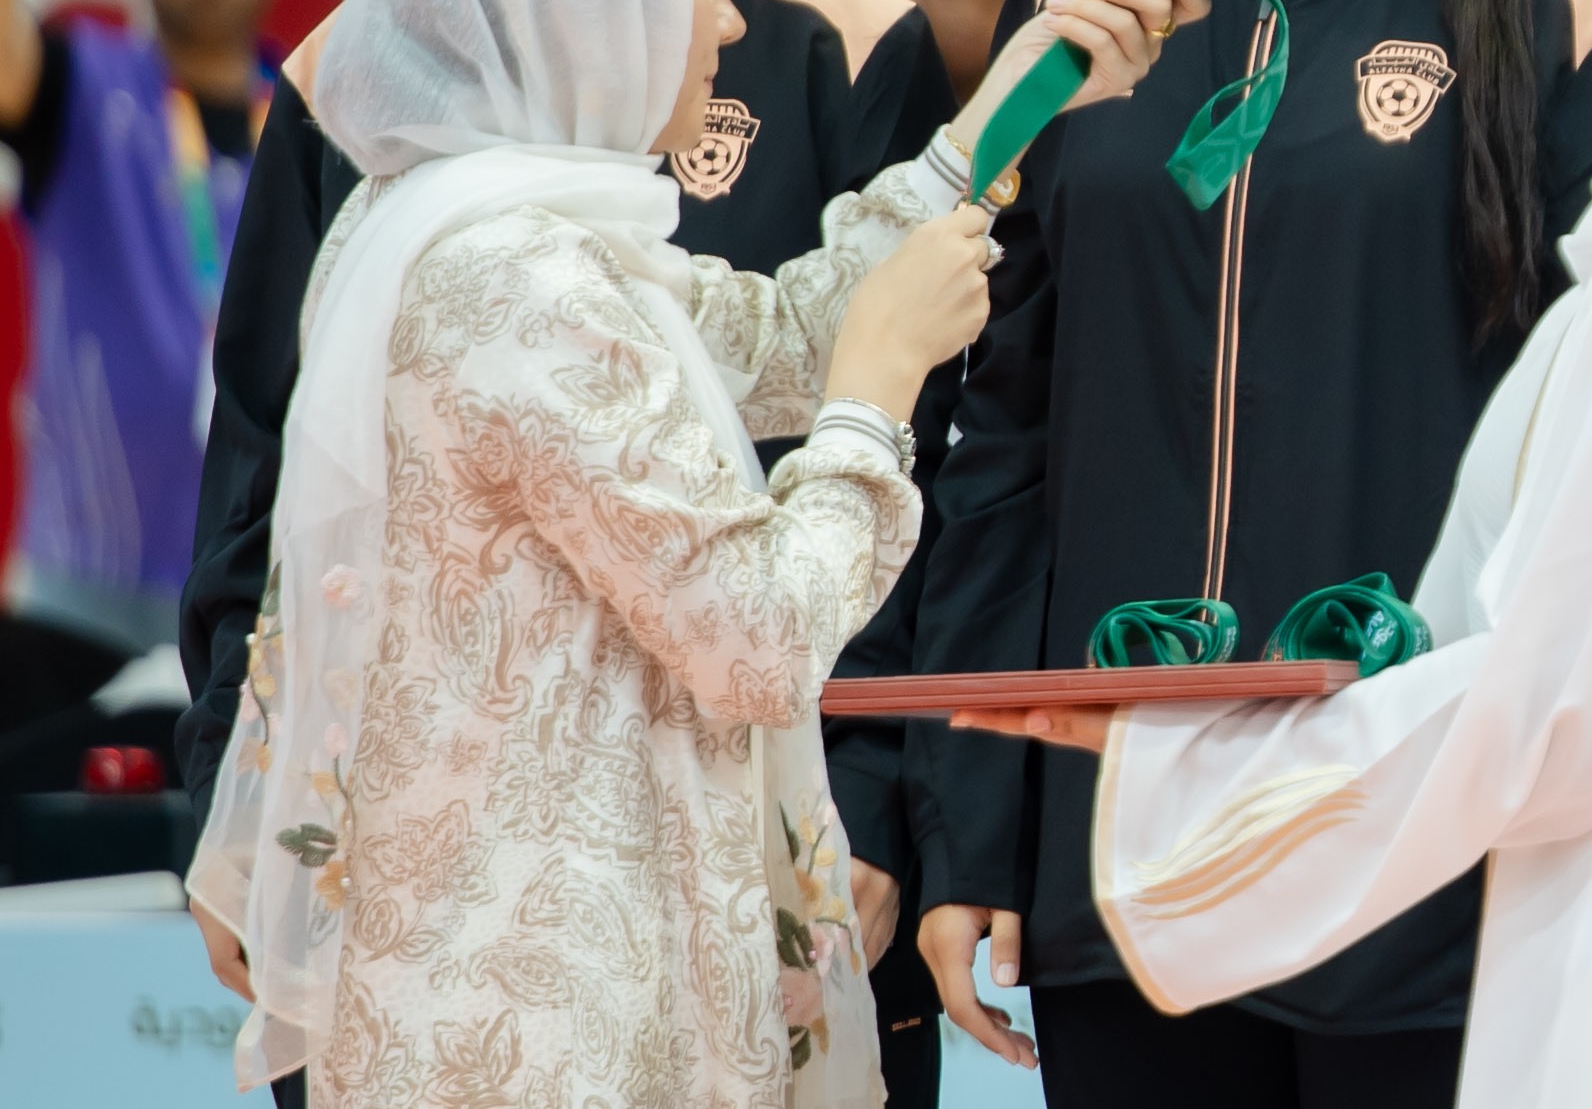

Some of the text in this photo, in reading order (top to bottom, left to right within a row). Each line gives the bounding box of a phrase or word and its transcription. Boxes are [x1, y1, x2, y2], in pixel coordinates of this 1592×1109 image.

[1368, 66, 1440, 85] ALFAYHA CLUB
[721, 125, 746, 137] CLUB
